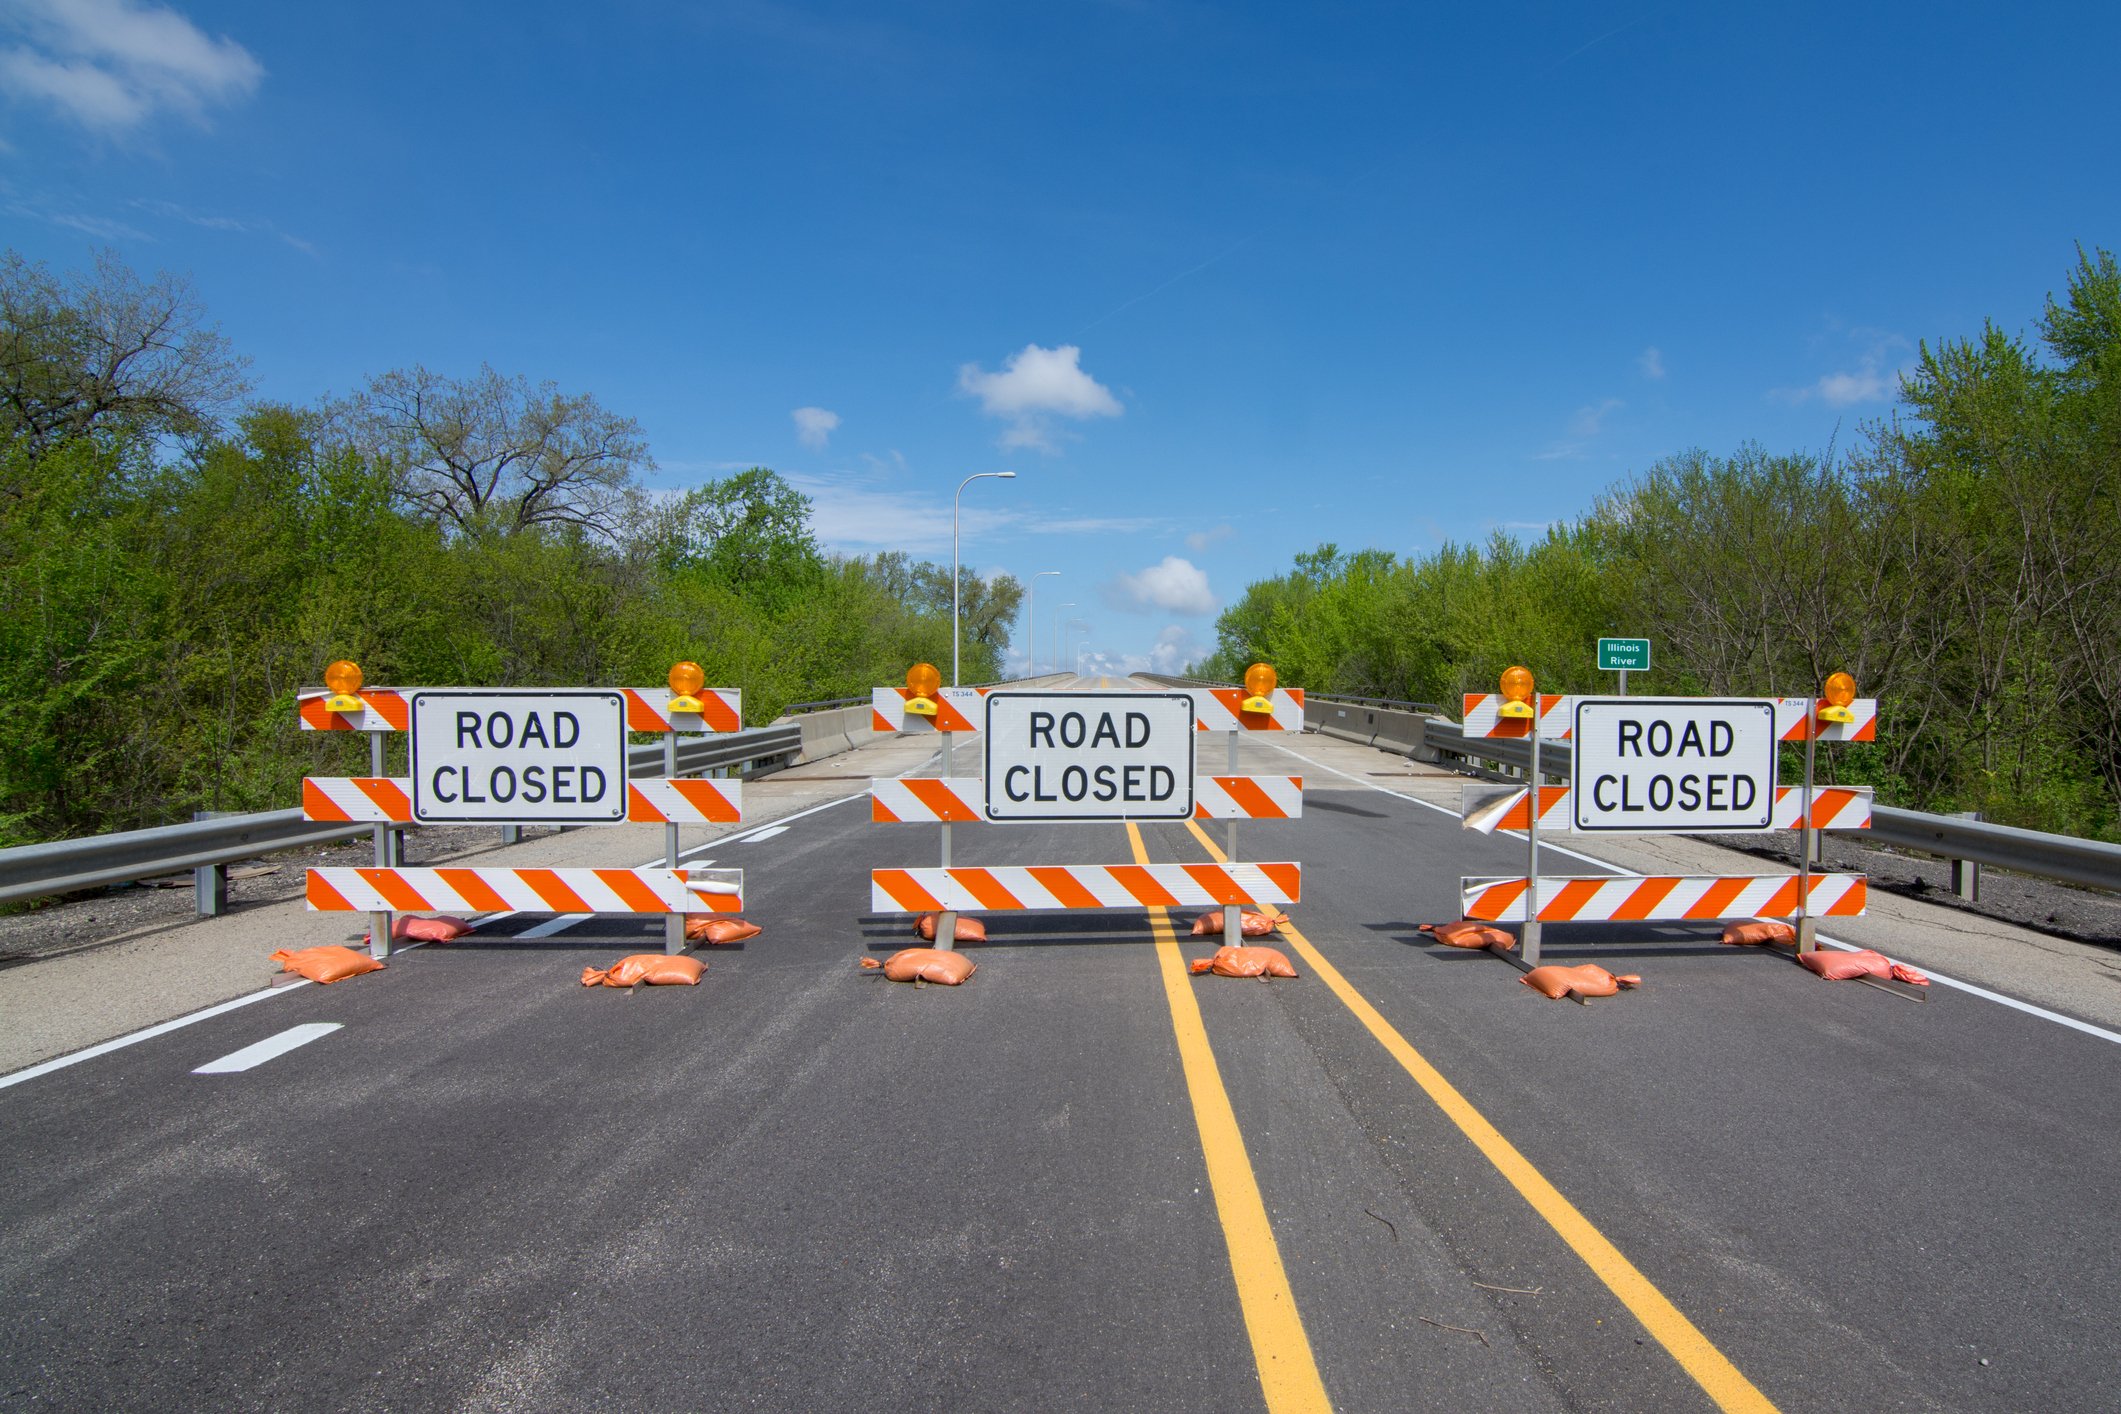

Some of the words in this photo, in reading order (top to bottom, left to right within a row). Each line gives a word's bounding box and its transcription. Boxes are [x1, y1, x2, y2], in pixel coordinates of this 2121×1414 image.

[1607, 643, 1640, 652] Illinois
[1610, 656, 1637, 665] River
[456, 711, 580, 749] ROAD
[1030, 711, 1151, 749] ROAD
[1618, 719, 1734, 758] ROAD
[432, 765, 607, 804] CLOSED
[1004, 765, 1175, 803] CLOSED
[1593, 774, 1756, 812] CLOSED
